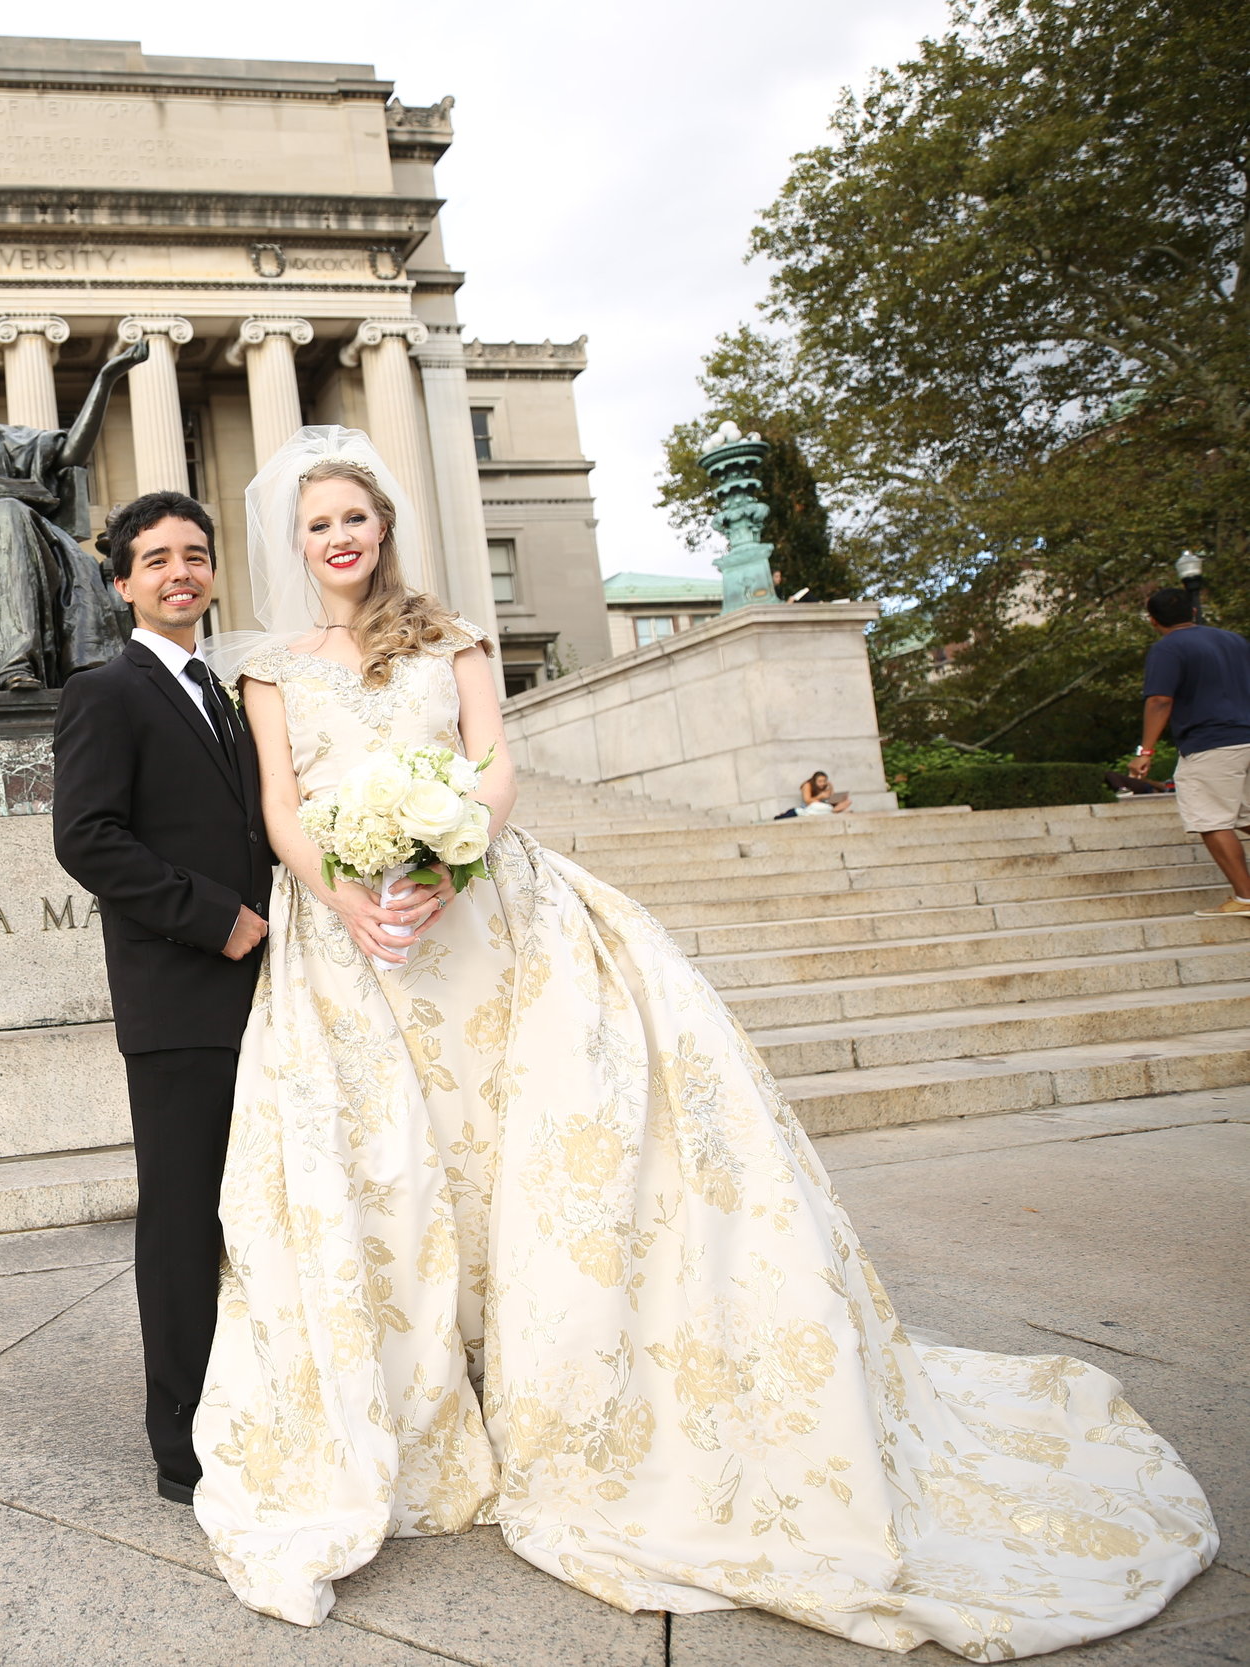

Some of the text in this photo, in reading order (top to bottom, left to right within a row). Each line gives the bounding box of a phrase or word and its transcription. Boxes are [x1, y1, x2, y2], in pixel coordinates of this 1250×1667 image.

[32, 100, 78, 117] NEW
[90, 102, 144, 119] YORK
[6, 135, 52, 149] STATE
[60, 136, 81, 149] OF
[90, 137, 125, 150] NEW
[134, 138, 175, 151] YORK
